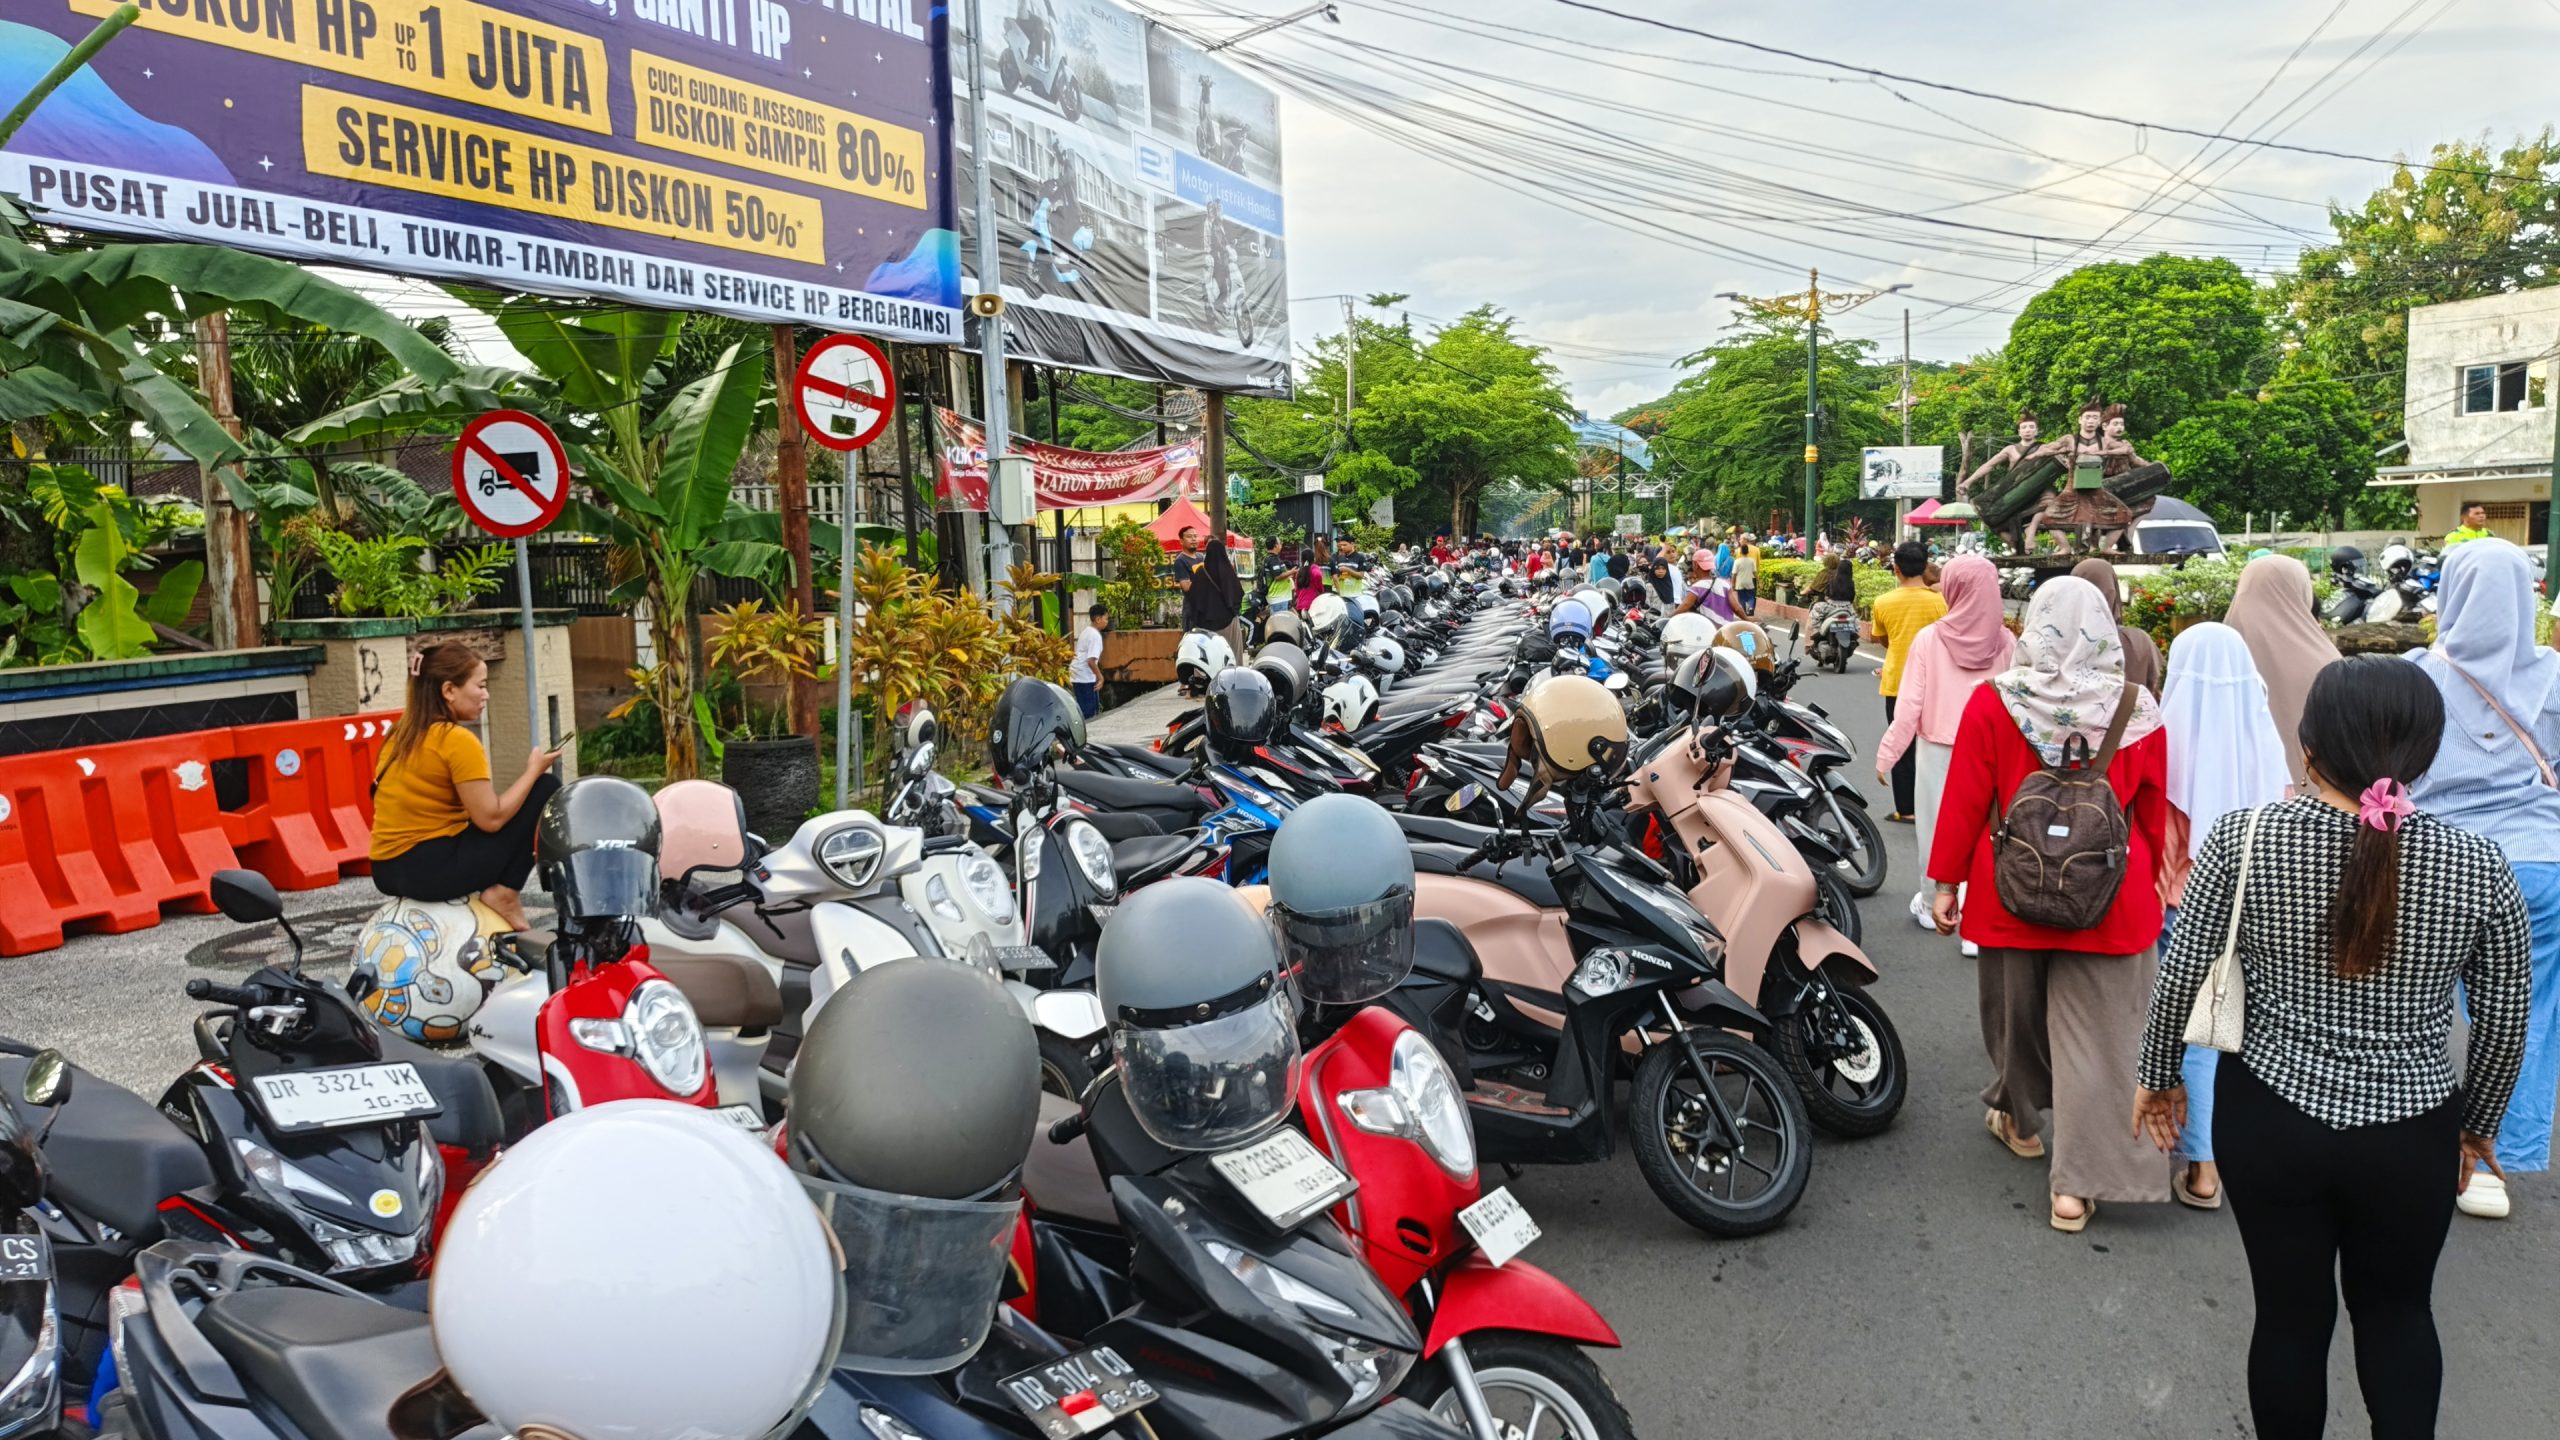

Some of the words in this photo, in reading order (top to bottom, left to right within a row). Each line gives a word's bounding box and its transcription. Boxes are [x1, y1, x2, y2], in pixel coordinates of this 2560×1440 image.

[316, 0, 377, 60] HP
[395, 22, 416, 46] UP
[749, 0, 791, 61] HP
[396, 47, 417, 72] TO
[420, 6, 446, 80] 1
[468, 21, 592, 115] JUTA
[647, 66, 683, 99] CUCI
[689, 79, 747, 116] GUDANG
[753, 97, 825, 137] AKSESORIS
[337, 106, 514, 194] SERVICE
[530, 146, 577, 204] HP
[592, 160, 714, 233] DISKON
[650, 96, 736, 152] DISKON
[745, 122, 827, 174] SAMPAI
[836, 122, 915, 195] 80%
[1182, 168, 1213, 193] Motor
[1216, 183, 1245, 207] Listrik
[1247, 199, 1276, 221] Honda
[28, 164, 168, 220] PUSAT
[187, 191, 391, 256] JUAL-BELI,
[401, 222, 636, 288] TUKAR-TAMBAH
[646, 262, 695, 297] DAN
[704, 274, 796, 312] SERVICE
[803, 288, 831, 316] HP
[838, 295, 951, 335] BERGARANSI
[1039, 471, 1092, 492] TAHUN
[1094, 472, 1130, 491] BARU
[1131, 467, 1158, 485] 2026
[1236, 808, 1266, 828] HONDA
[1631, 949, 1673, 971] HONDA
[264, 1079, 300, 1100] DR
[312, 1072, 374, 1094] 3324
[384, 1068, 418, 1087] VK
[3, 1238, 39, 1260] CS
[1009, 1376, 1058, 1411] DR
[1044, 1357, 1102, 1395] 5114
